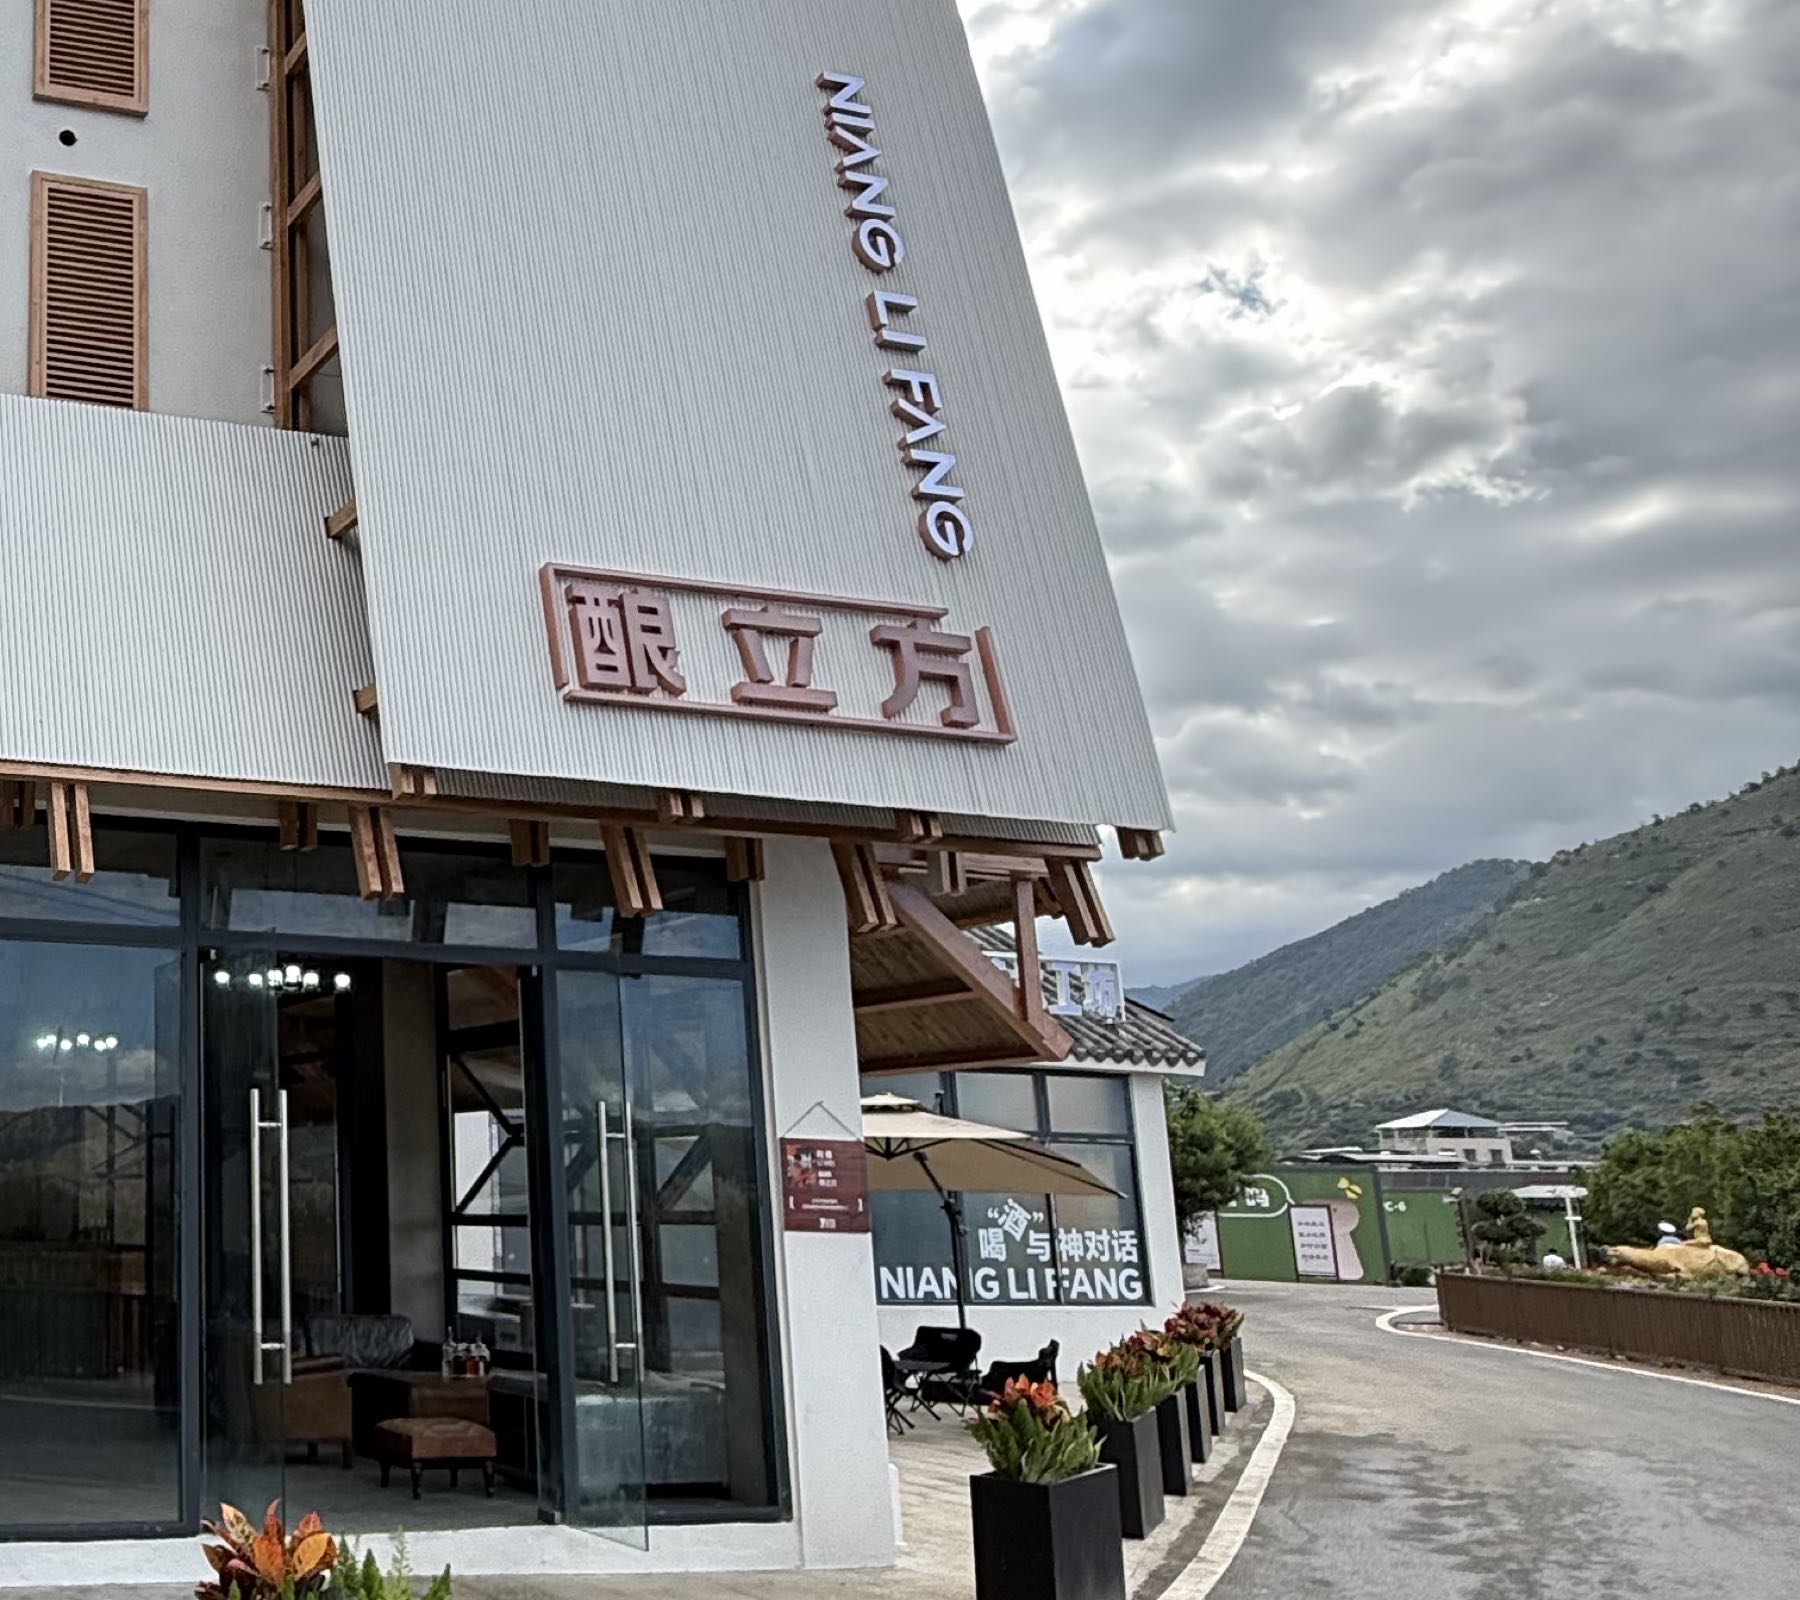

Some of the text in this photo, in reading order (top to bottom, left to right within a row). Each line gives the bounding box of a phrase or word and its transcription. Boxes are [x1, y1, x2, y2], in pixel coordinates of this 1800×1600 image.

[815, 70, 975, 562] NIANG LI FANG
[564, 582, 980, 730] 酿立方
[1007, 1267, 1038, 1300] LI
[1044, 1267, 1143, 1300] FANG
